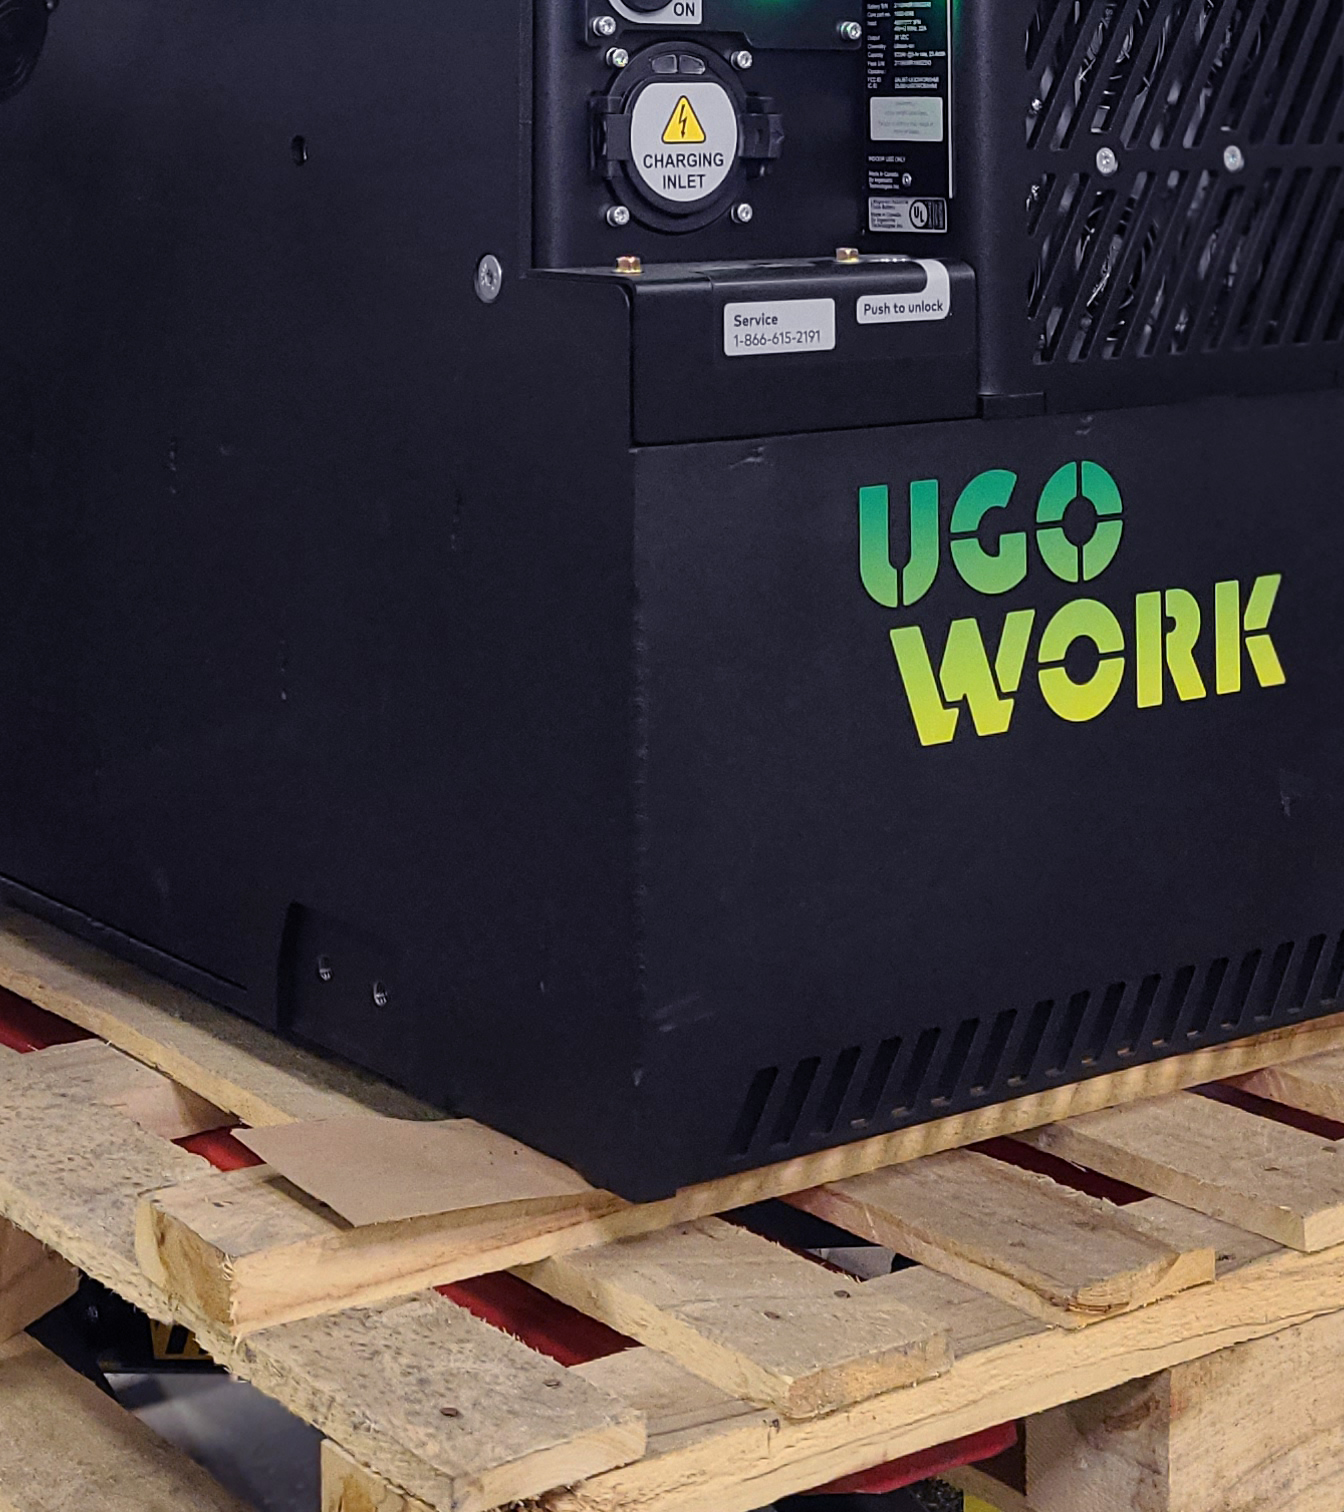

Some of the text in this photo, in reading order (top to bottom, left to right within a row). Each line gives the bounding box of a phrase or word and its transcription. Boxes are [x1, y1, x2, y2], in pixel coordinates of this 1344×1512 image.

[673, 2, 695, 17] ON
[643, 152, 724, 169] CHARGING
[662, 174, 706, 190] INLET
[863, 300, 944, 316] Push to unlock
[733, 313, 779, 327] Service
[733, 330, 821, 347] 1-866-615-2191
[859, 460, 1123, 609] UGO
[889, 573, 1286, 747] WORK
